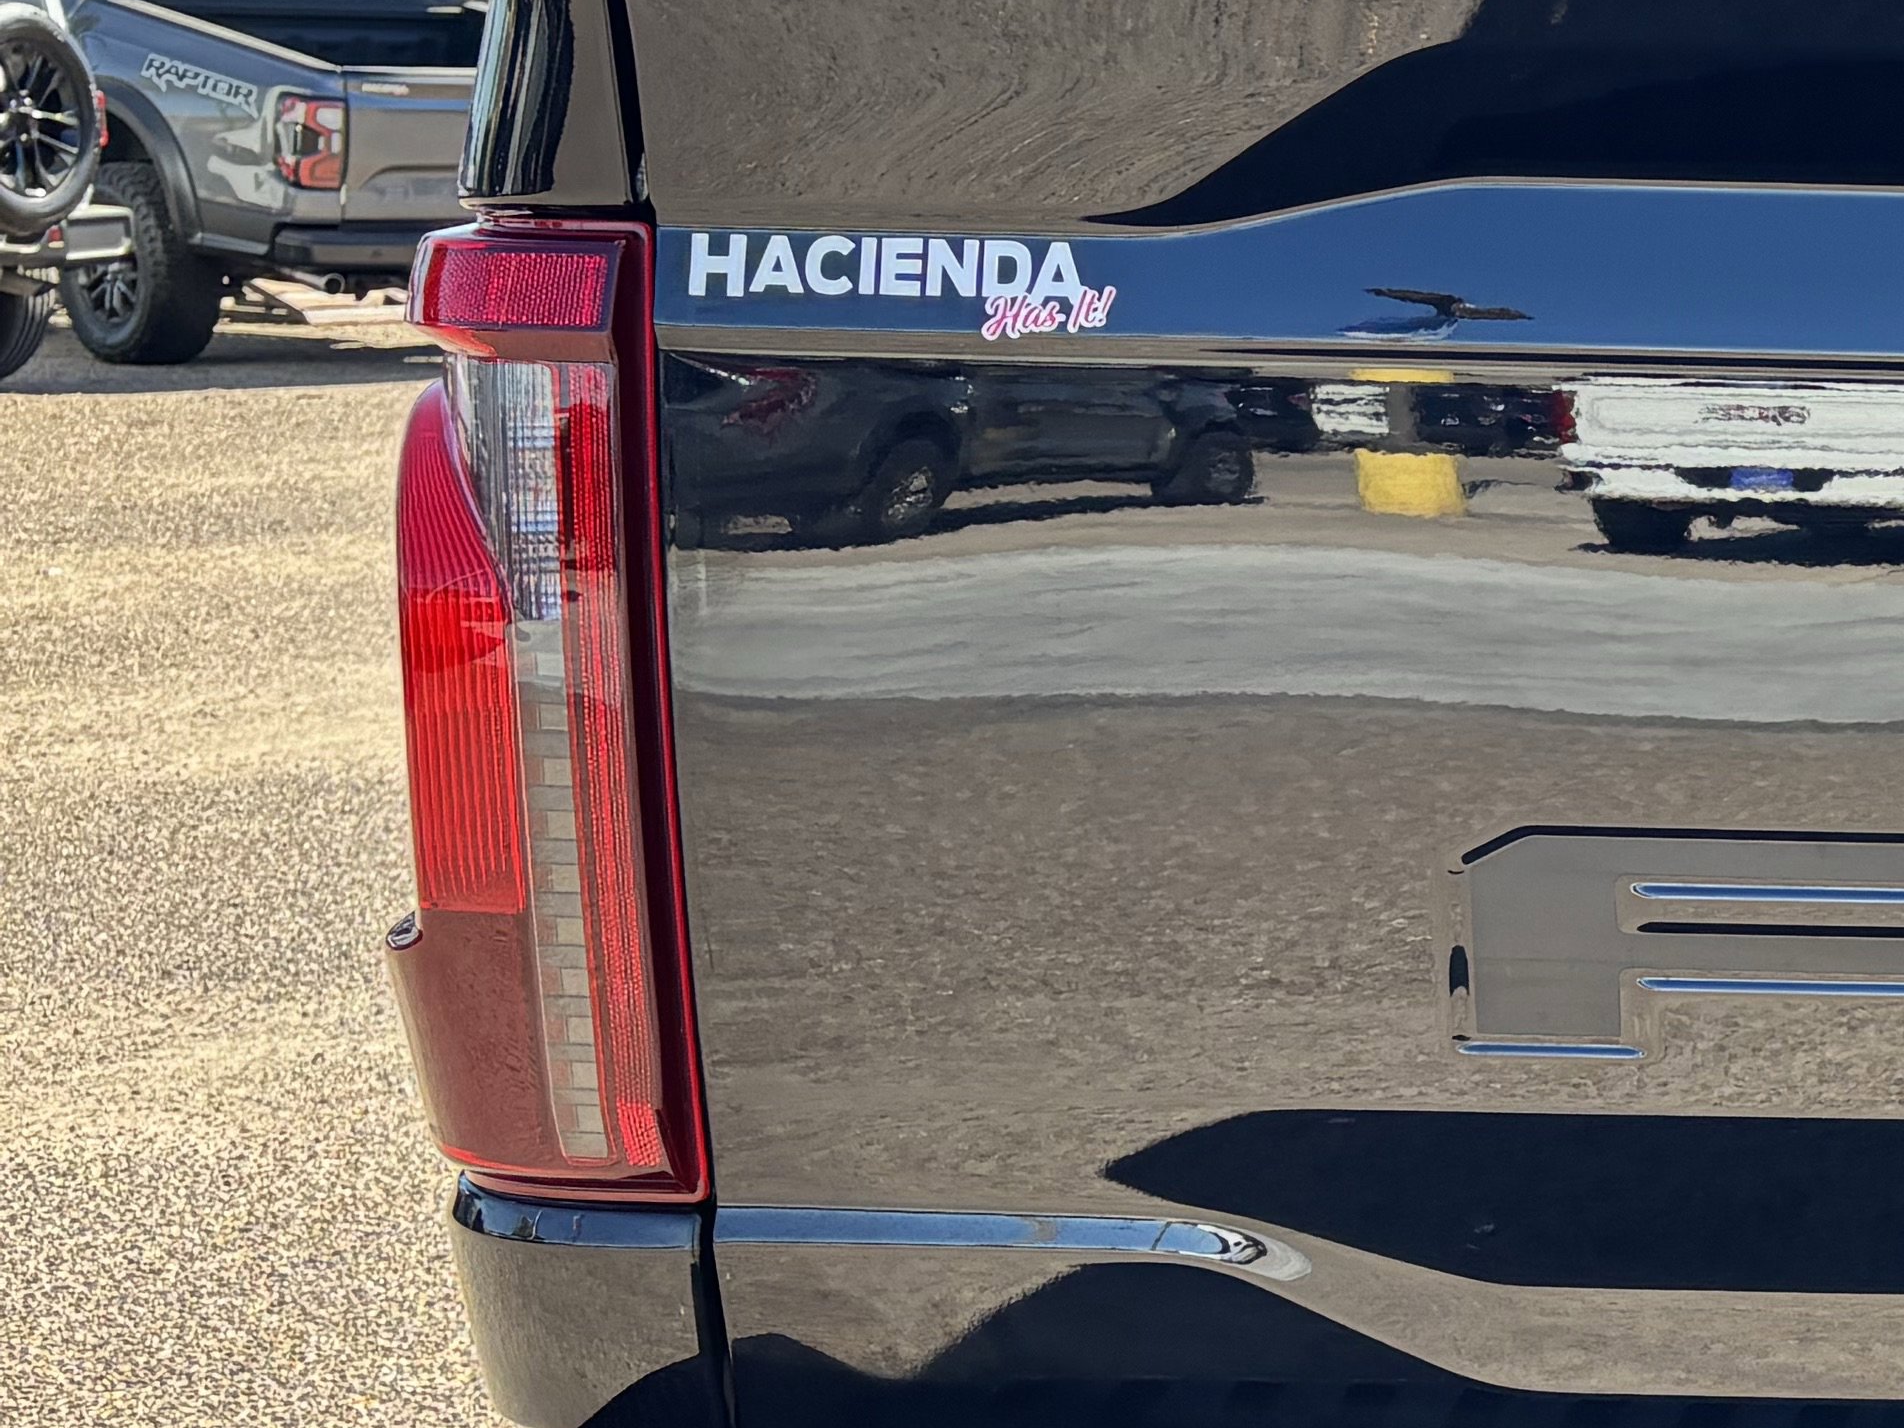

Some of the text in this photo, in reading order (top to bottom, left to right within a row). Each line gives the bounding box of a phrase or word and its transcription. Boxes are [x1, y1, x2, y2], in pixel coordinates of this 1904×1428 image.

[142, 55, 257, 112] RAPTOR
[688, 232, 1082, 305] HACIENDA
[982, 286, 1116, 340] Has It!
